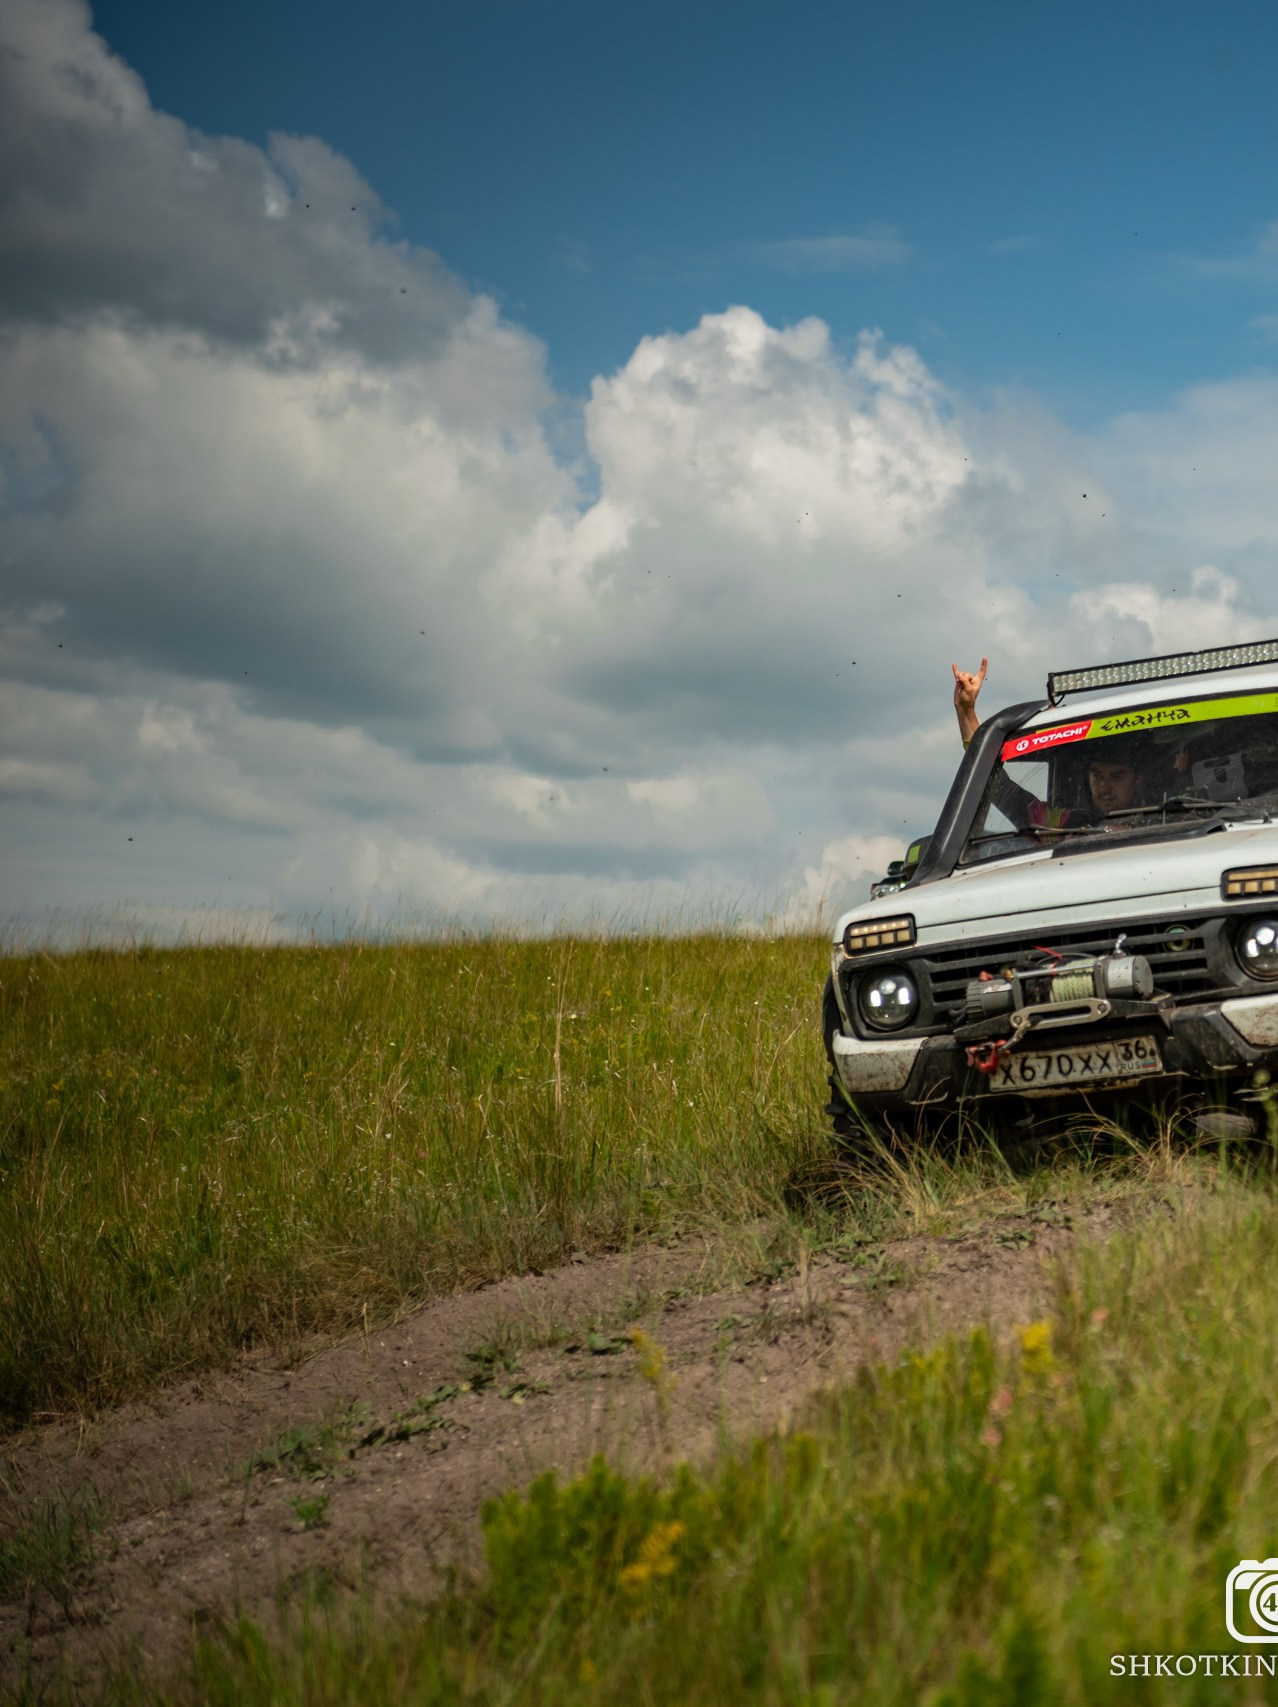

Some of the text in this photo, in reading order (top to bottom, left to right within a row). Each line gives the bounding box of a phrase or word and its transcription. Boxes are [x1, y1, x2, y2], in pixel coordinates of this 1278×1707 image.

[1032, 726, 1083, 745] TOTACHI
[1117, 1039, 1148, 1061] 36
[1120, 1059, 1141, 1071] RUS
